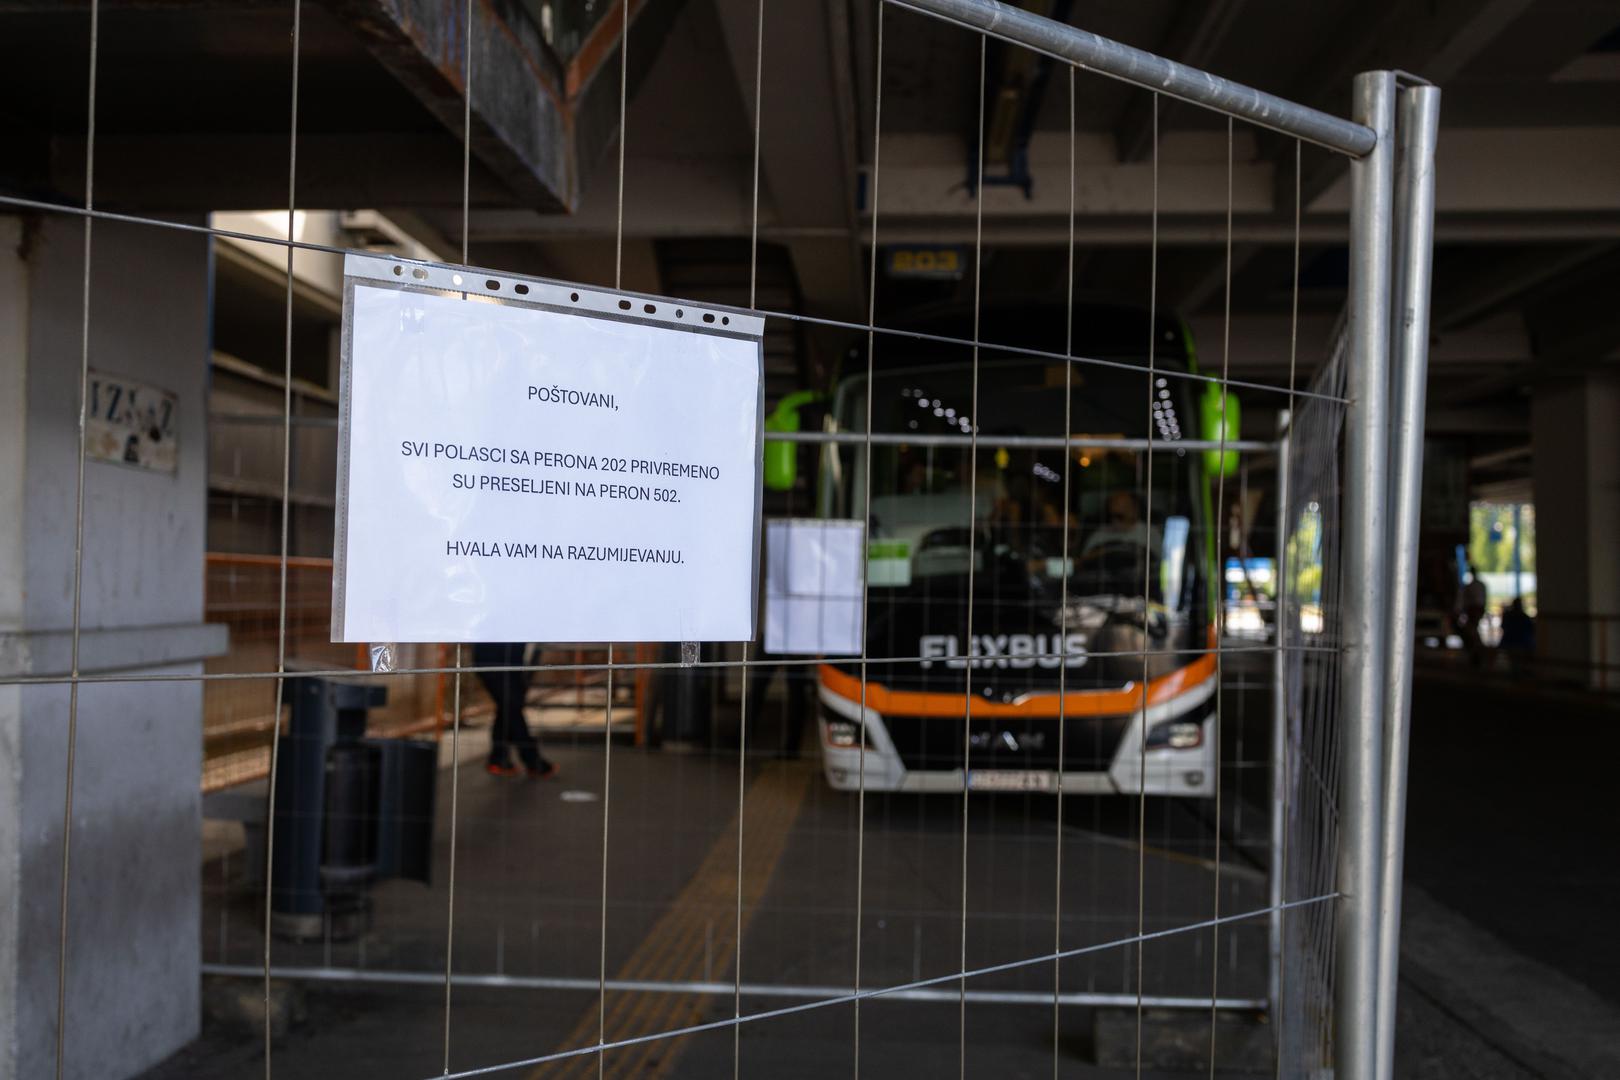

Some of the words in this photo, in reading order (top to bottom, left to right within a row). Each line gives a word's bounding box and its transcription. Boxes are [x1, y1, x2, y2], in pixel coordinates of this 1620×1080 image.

[529, 385, 618, 411] POŠTOVANI,
[402, 441, 428, 457] SVI
[435, 444, 505, 463] POLASCI
[511, 450, 530, 465] SA
[535, 452, 597, 470] PERONA
[601, 458, 626, 472] 202
[631, 460, 719, 479] PRIVREMENO
[453, 474, 475, 489] SU
[481, 476, 570, 495] PRESELJENI
[575, 482, 596, 497] NA
[600, 484, 649, 500] PERON
[654, 488, 680, 502] 502.
[447, 541, 501, 557] HVALA
[504, 543, 537, 558] VAM
[542, 545, 563, 559] NA
[568, 546, 684, 564] RAZUMIJEVANJU.
